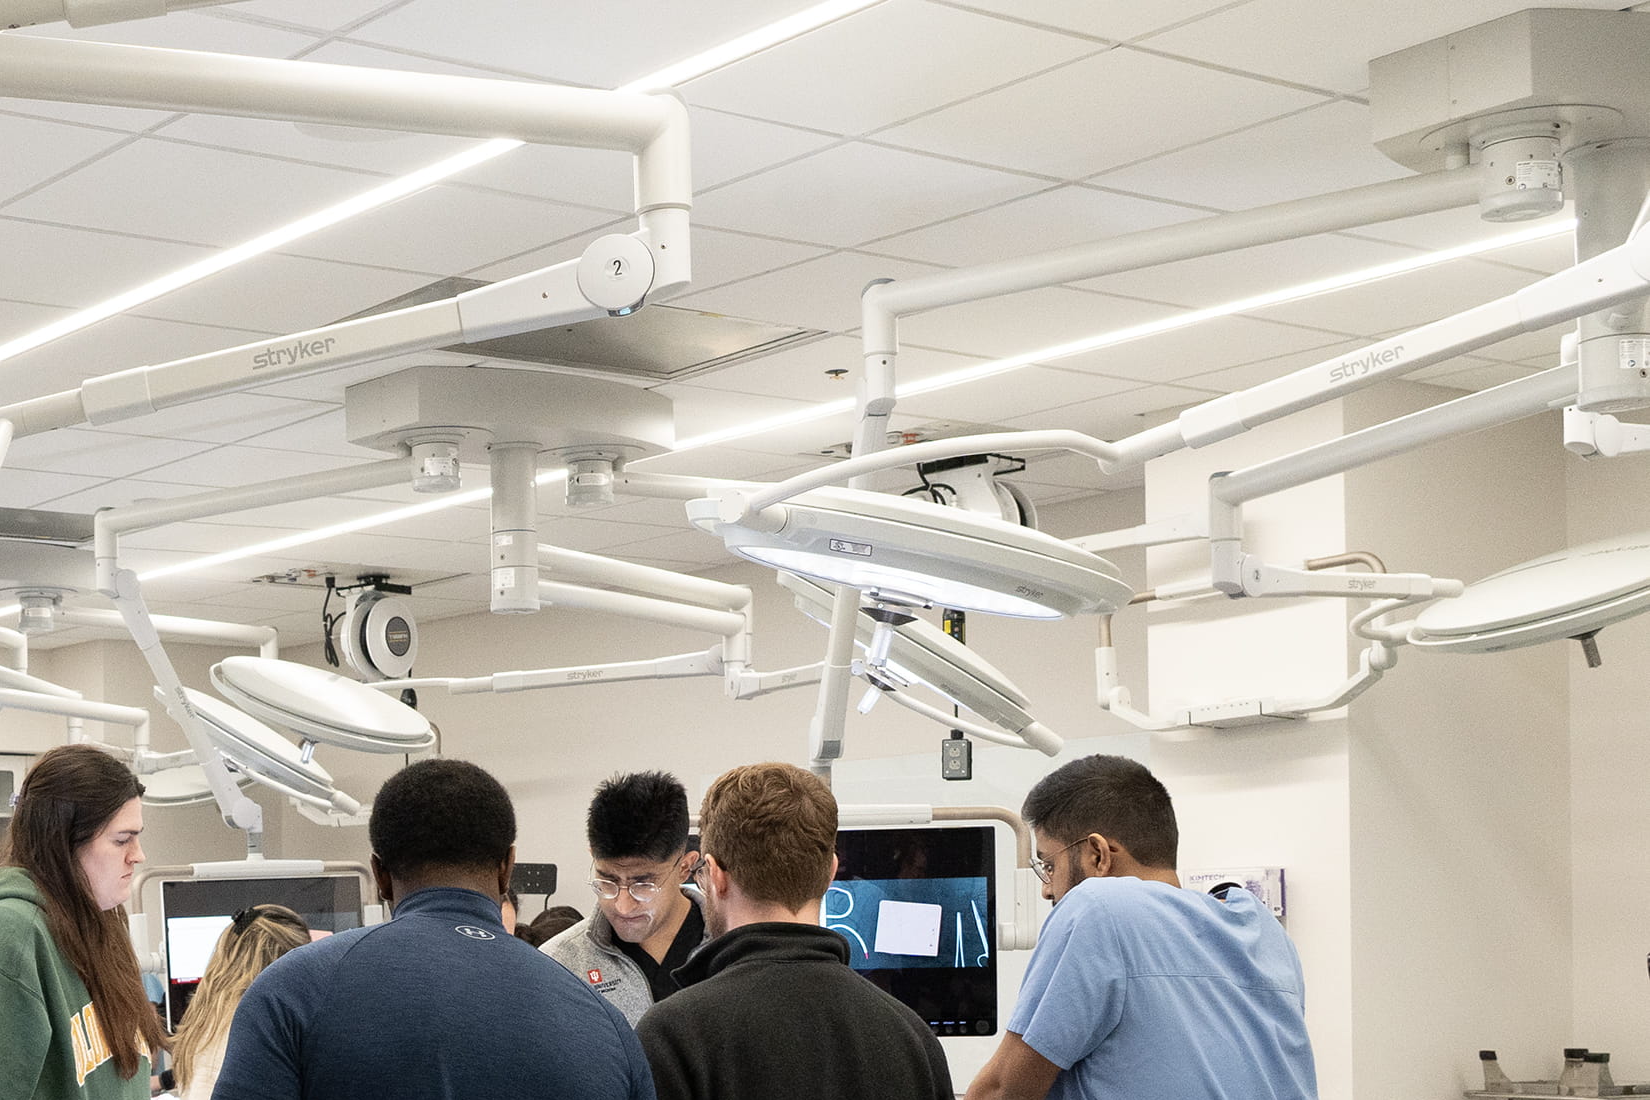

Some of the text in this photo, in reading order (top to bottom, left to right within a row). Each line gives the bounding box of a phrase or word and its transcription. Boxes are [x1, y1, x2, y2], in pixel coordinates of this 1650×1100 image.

[613, 260, 622, 276] 2
[252, 337, 336, 370] stryker
[1329, 345, 1404, 383] stryker
